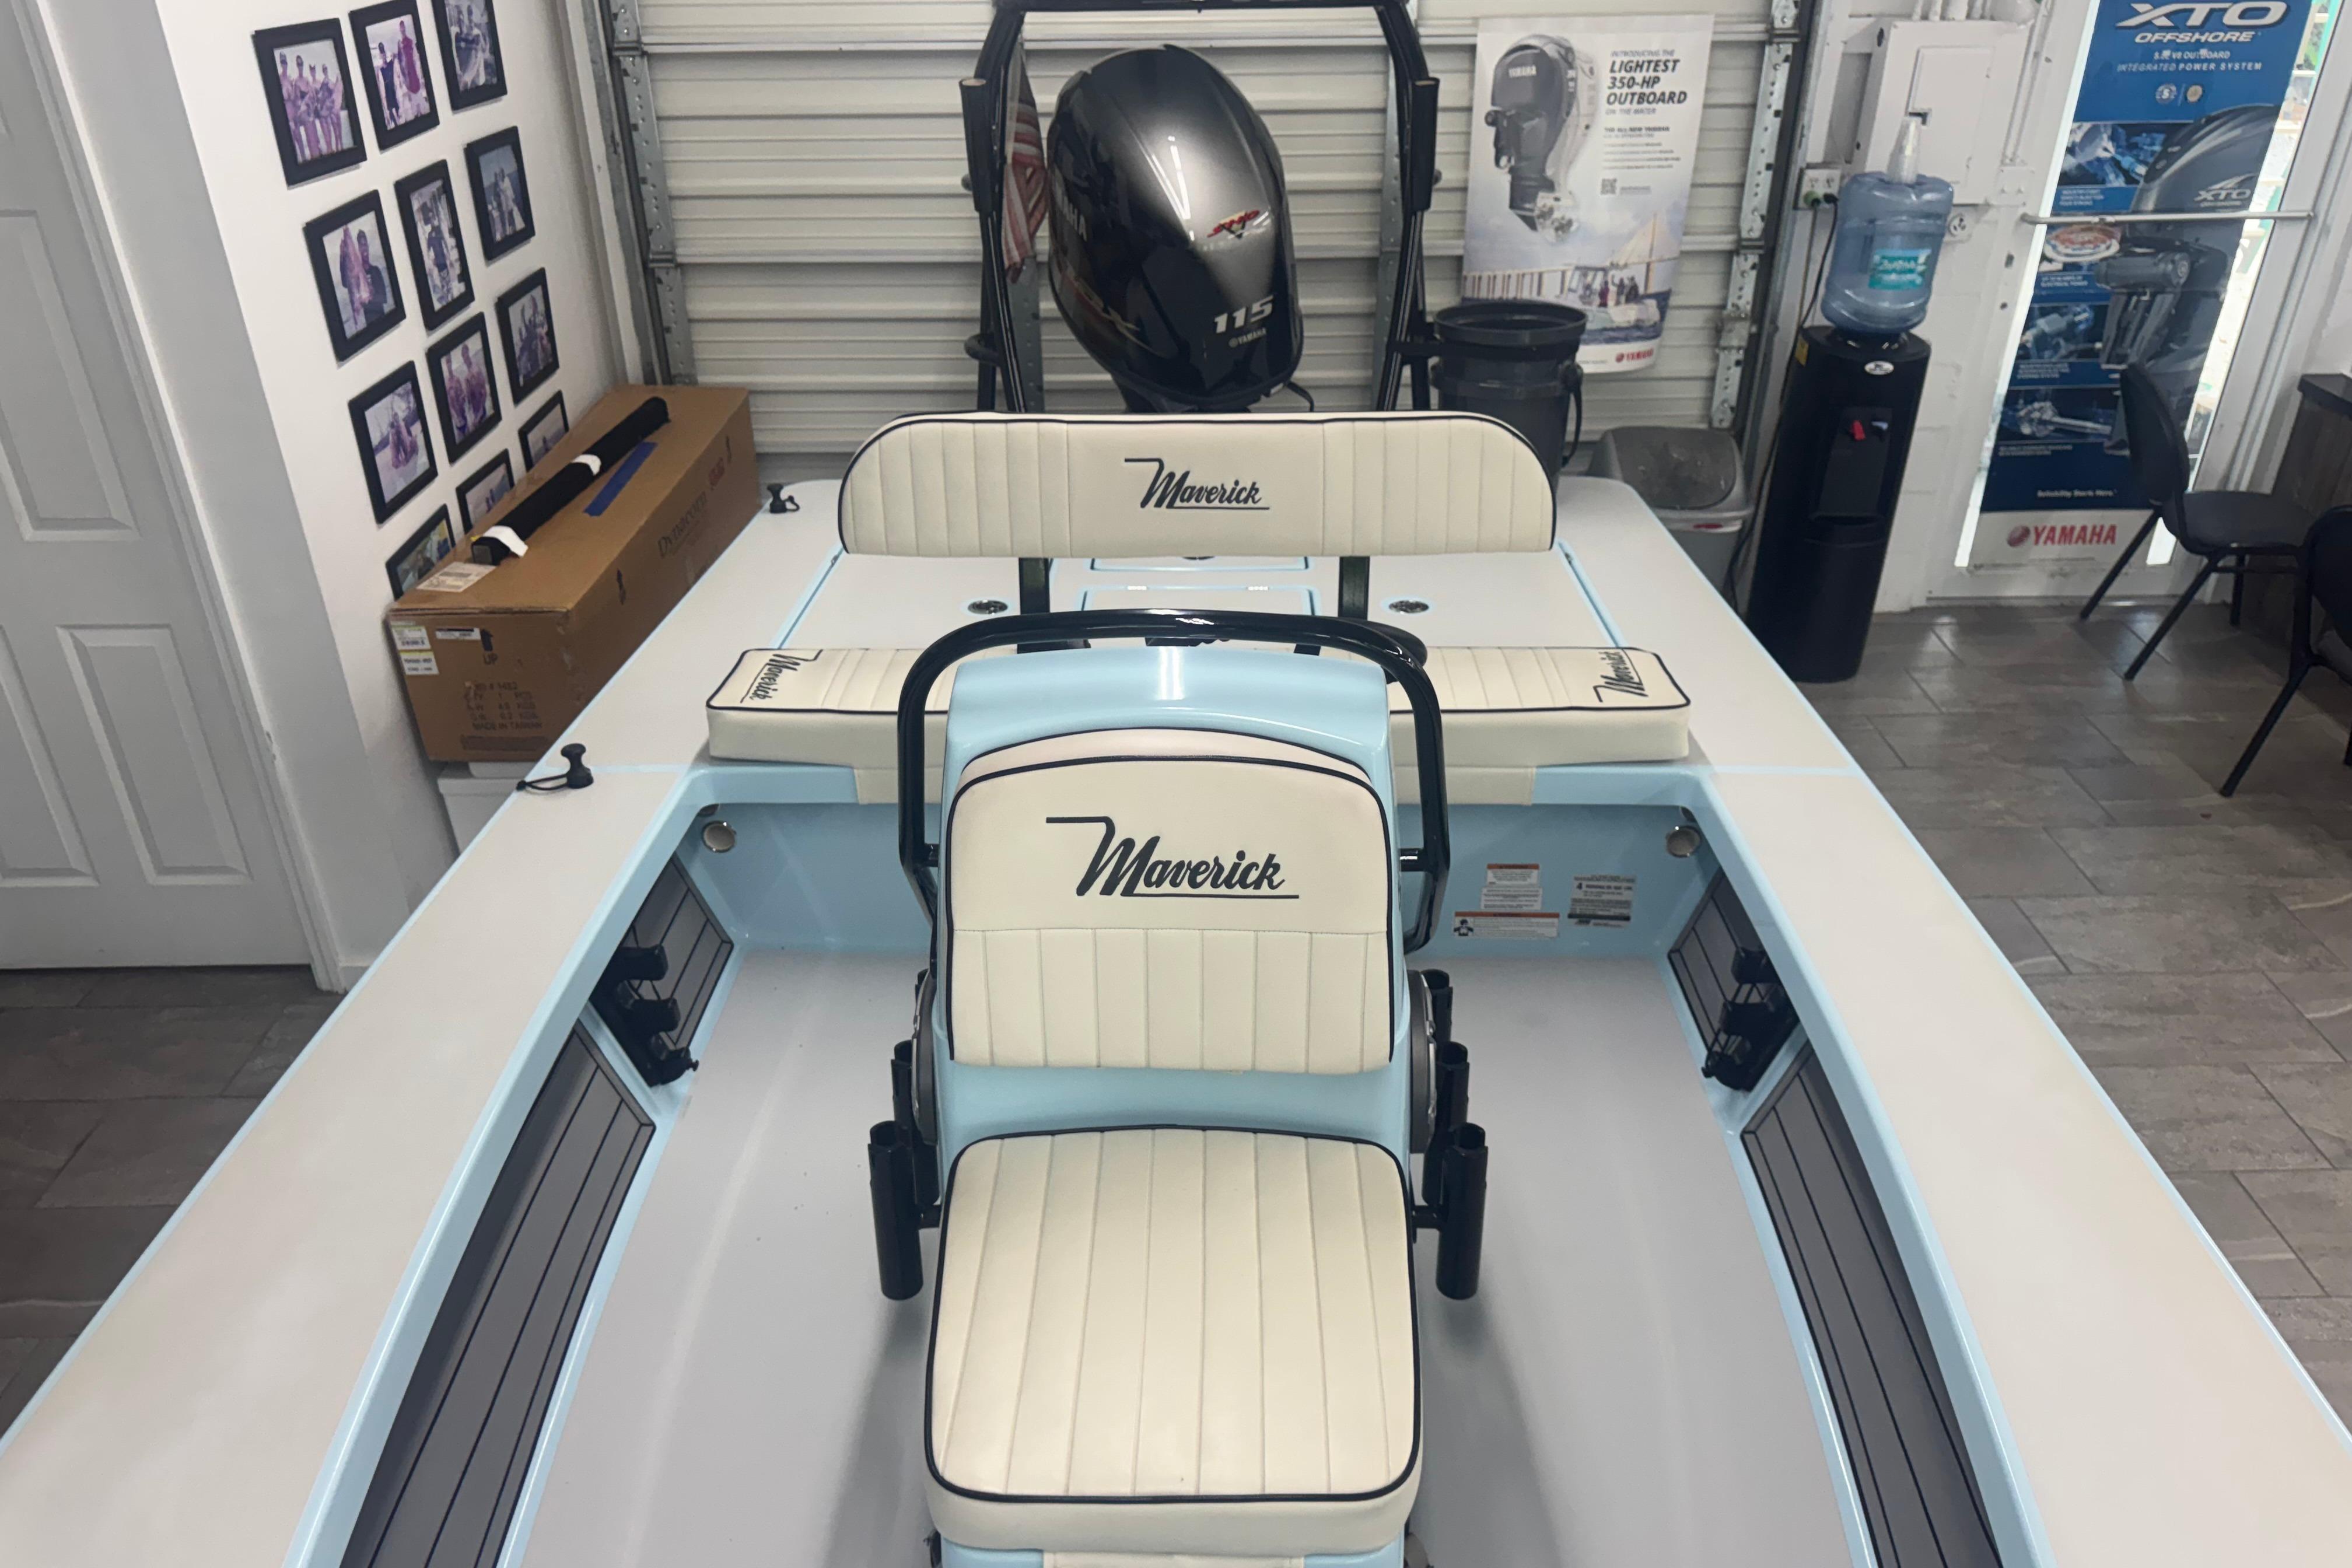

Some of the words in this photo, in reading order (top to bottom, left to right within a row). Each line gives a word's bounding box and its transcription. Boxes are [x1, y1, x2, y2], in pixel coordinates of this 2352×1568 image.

[2116, 1, 2287, 27] XTO
[2134, 31, 2256, 43] OFFSHORE
[1609, 59, 1681, 74] LIGHTEST
[2117, 63, 2176, 72] INTEGRATED
[2178, 62, 2216, 71] POWER
[2220, 62, 2262, 71] SYSTEM
[1607, 75, 1661, 89] 350-HP
[1606, 90, 1688, 106] OUTBOARD
[2194, 189, 2252, 201] XTO
[1214, 295, 1274, 333] 115
[1237, 327, 1266, 345] YAMAHA
[1125, 458, 1270, 510] Maverick
[2033, 524, 2117, 545] YAMAHA
[483, 653, 498, 665] UP
[740, 649, 824, 704] Maverick
[1593, 649, 1648, 702] Maverick
[1046, 816, 1300, 899] Maverick
[1577, 882, 1583, 890] 4
